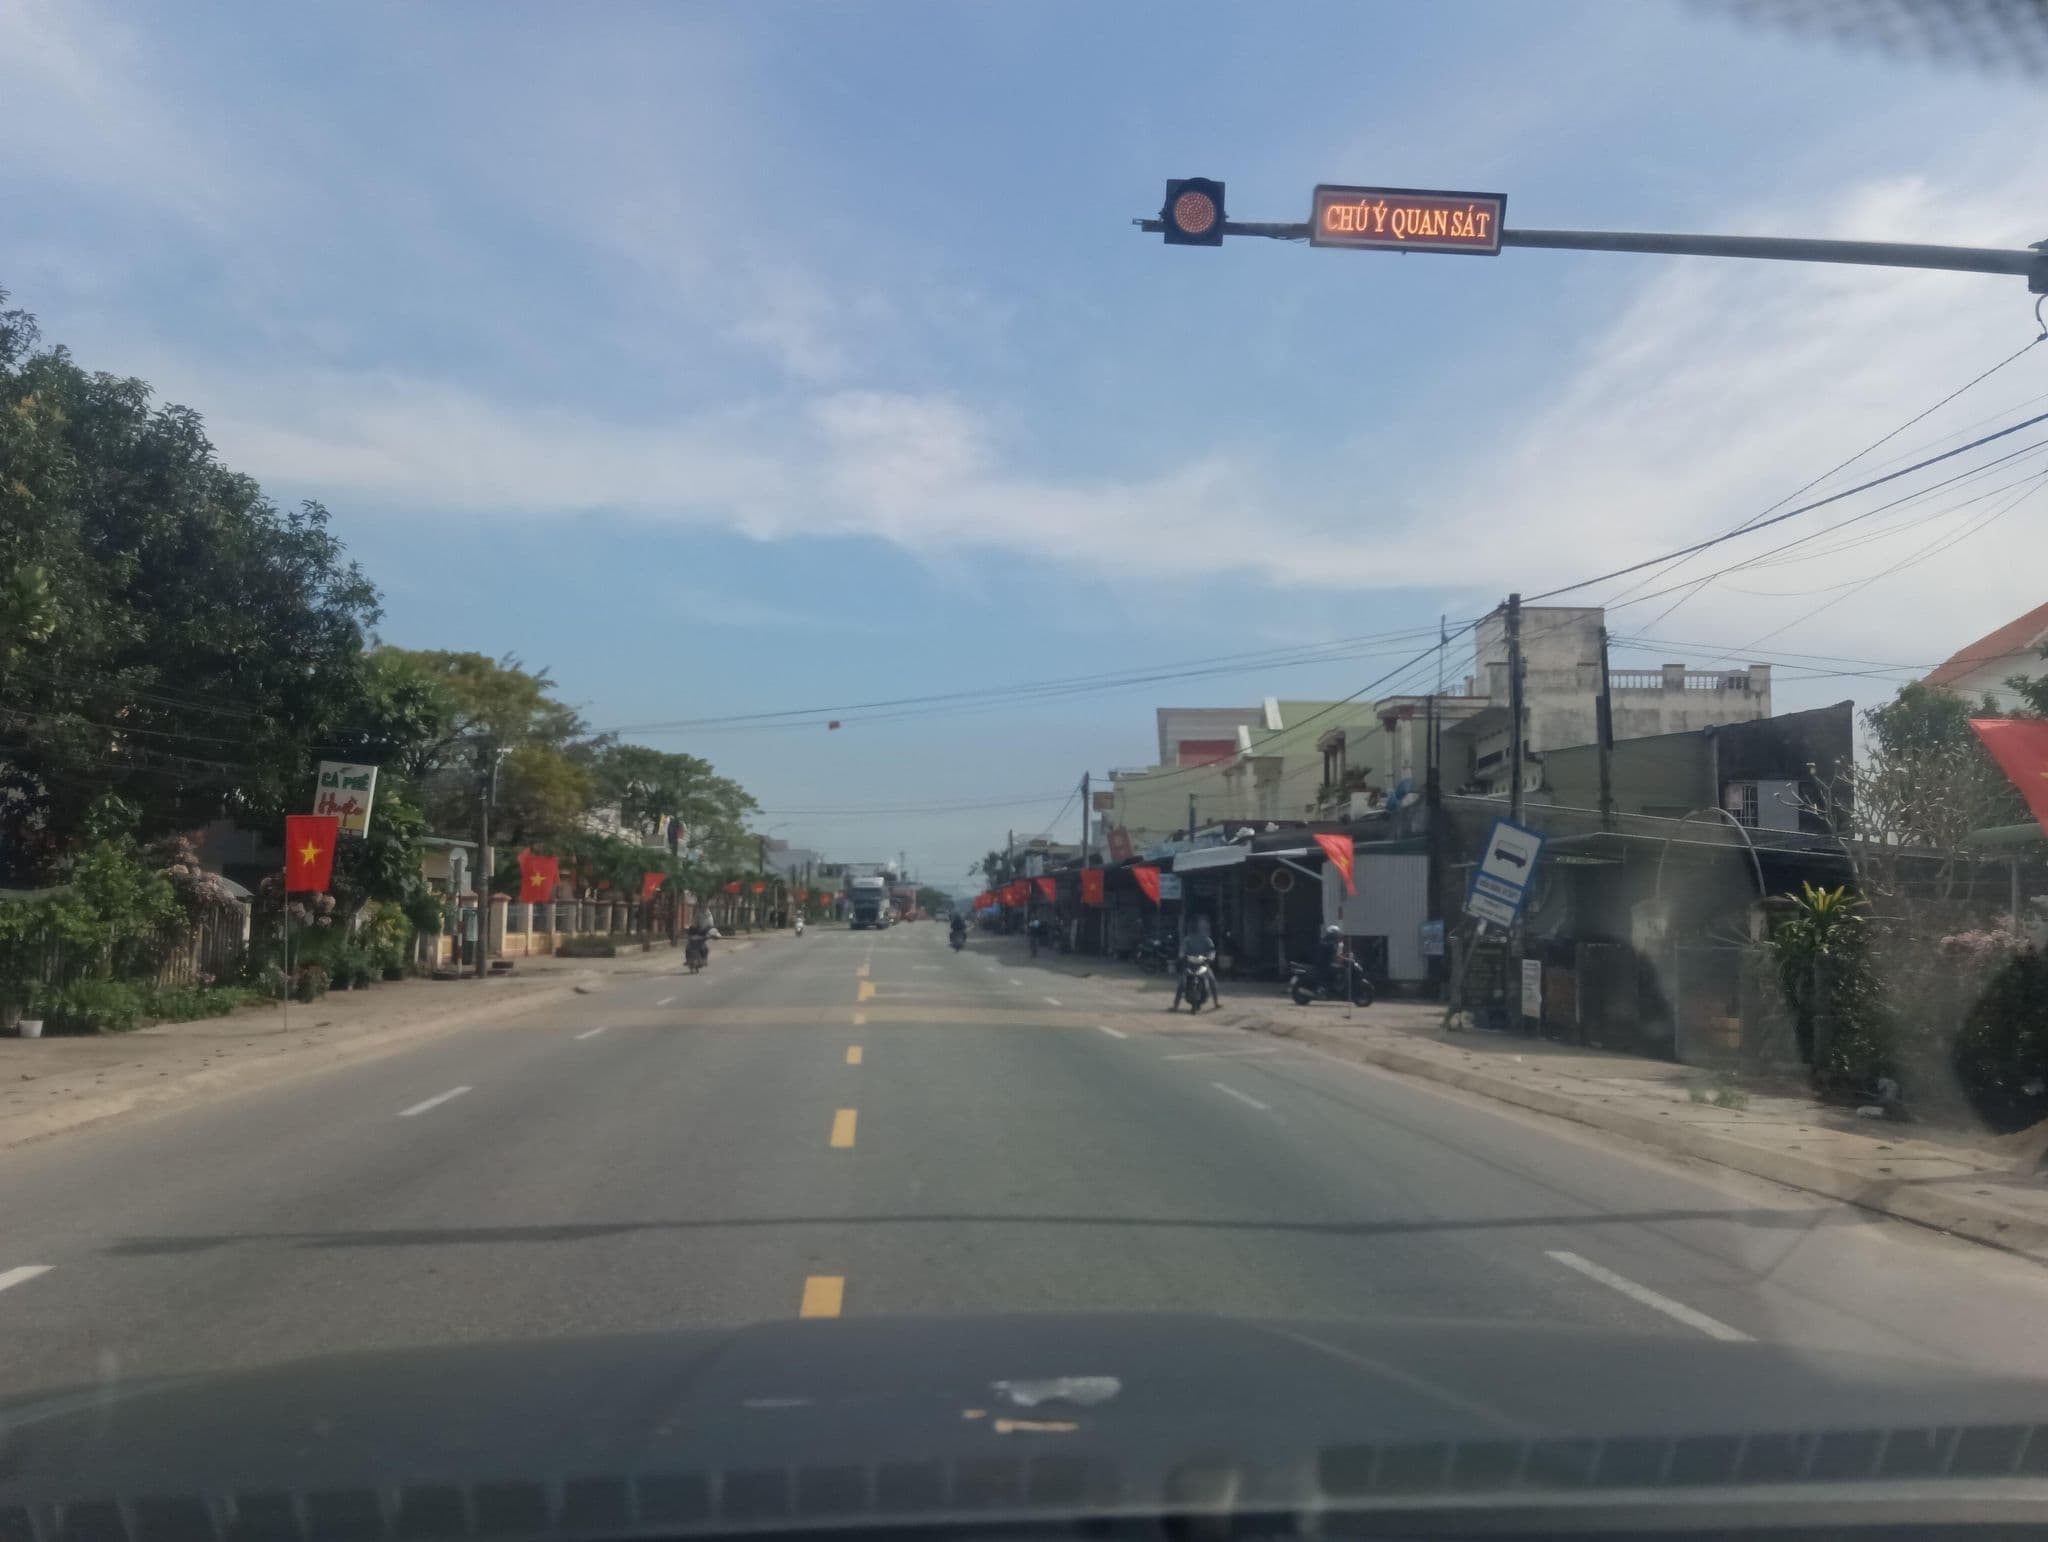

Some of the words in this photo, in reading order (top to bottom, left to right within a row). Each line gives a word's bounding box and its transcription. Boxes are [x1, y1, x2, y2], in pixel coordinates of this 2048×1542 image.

[1327, 200, 1370, 232] CHÚ
[1373, 200, 1388, 233] Ý
[1391, 208, 1448, 239] QUAN
[1451, 205, 1490, 237] SÁT
